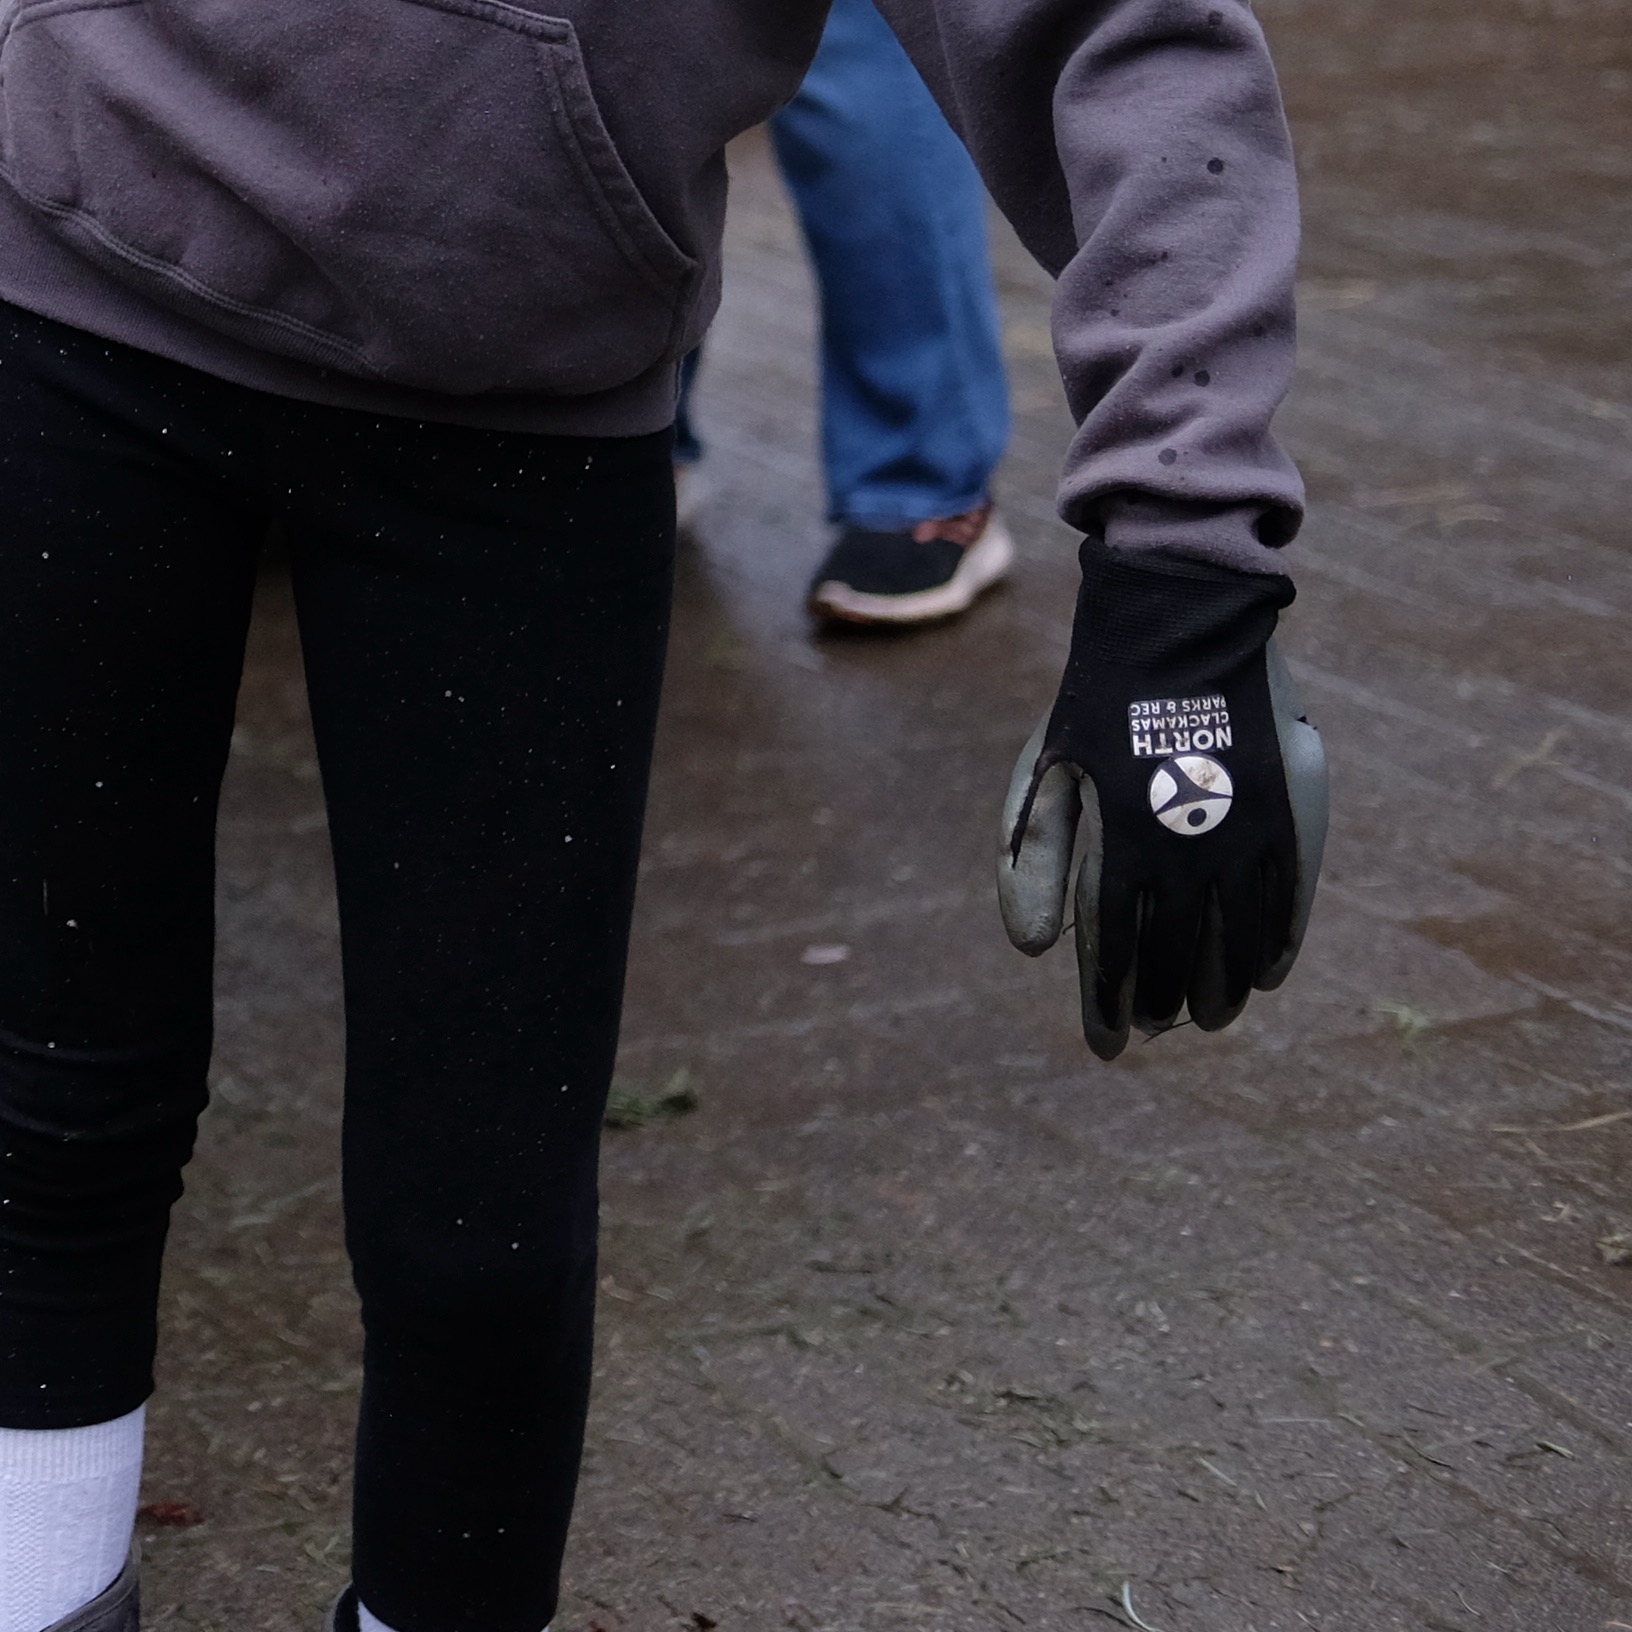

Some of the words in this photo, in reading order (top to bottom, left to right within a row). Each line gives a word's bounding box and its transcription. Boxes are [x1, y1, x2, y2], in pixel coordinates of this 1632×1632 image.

[1130, 701, 1160, 716] REC
[1166, 701, 1177, 714] &
[1181, 693, 1227, 712] PARKS
[1131, 711, 1230, 732] CLACKAMAS
[1132, 725, 1233, 756] NORTH
